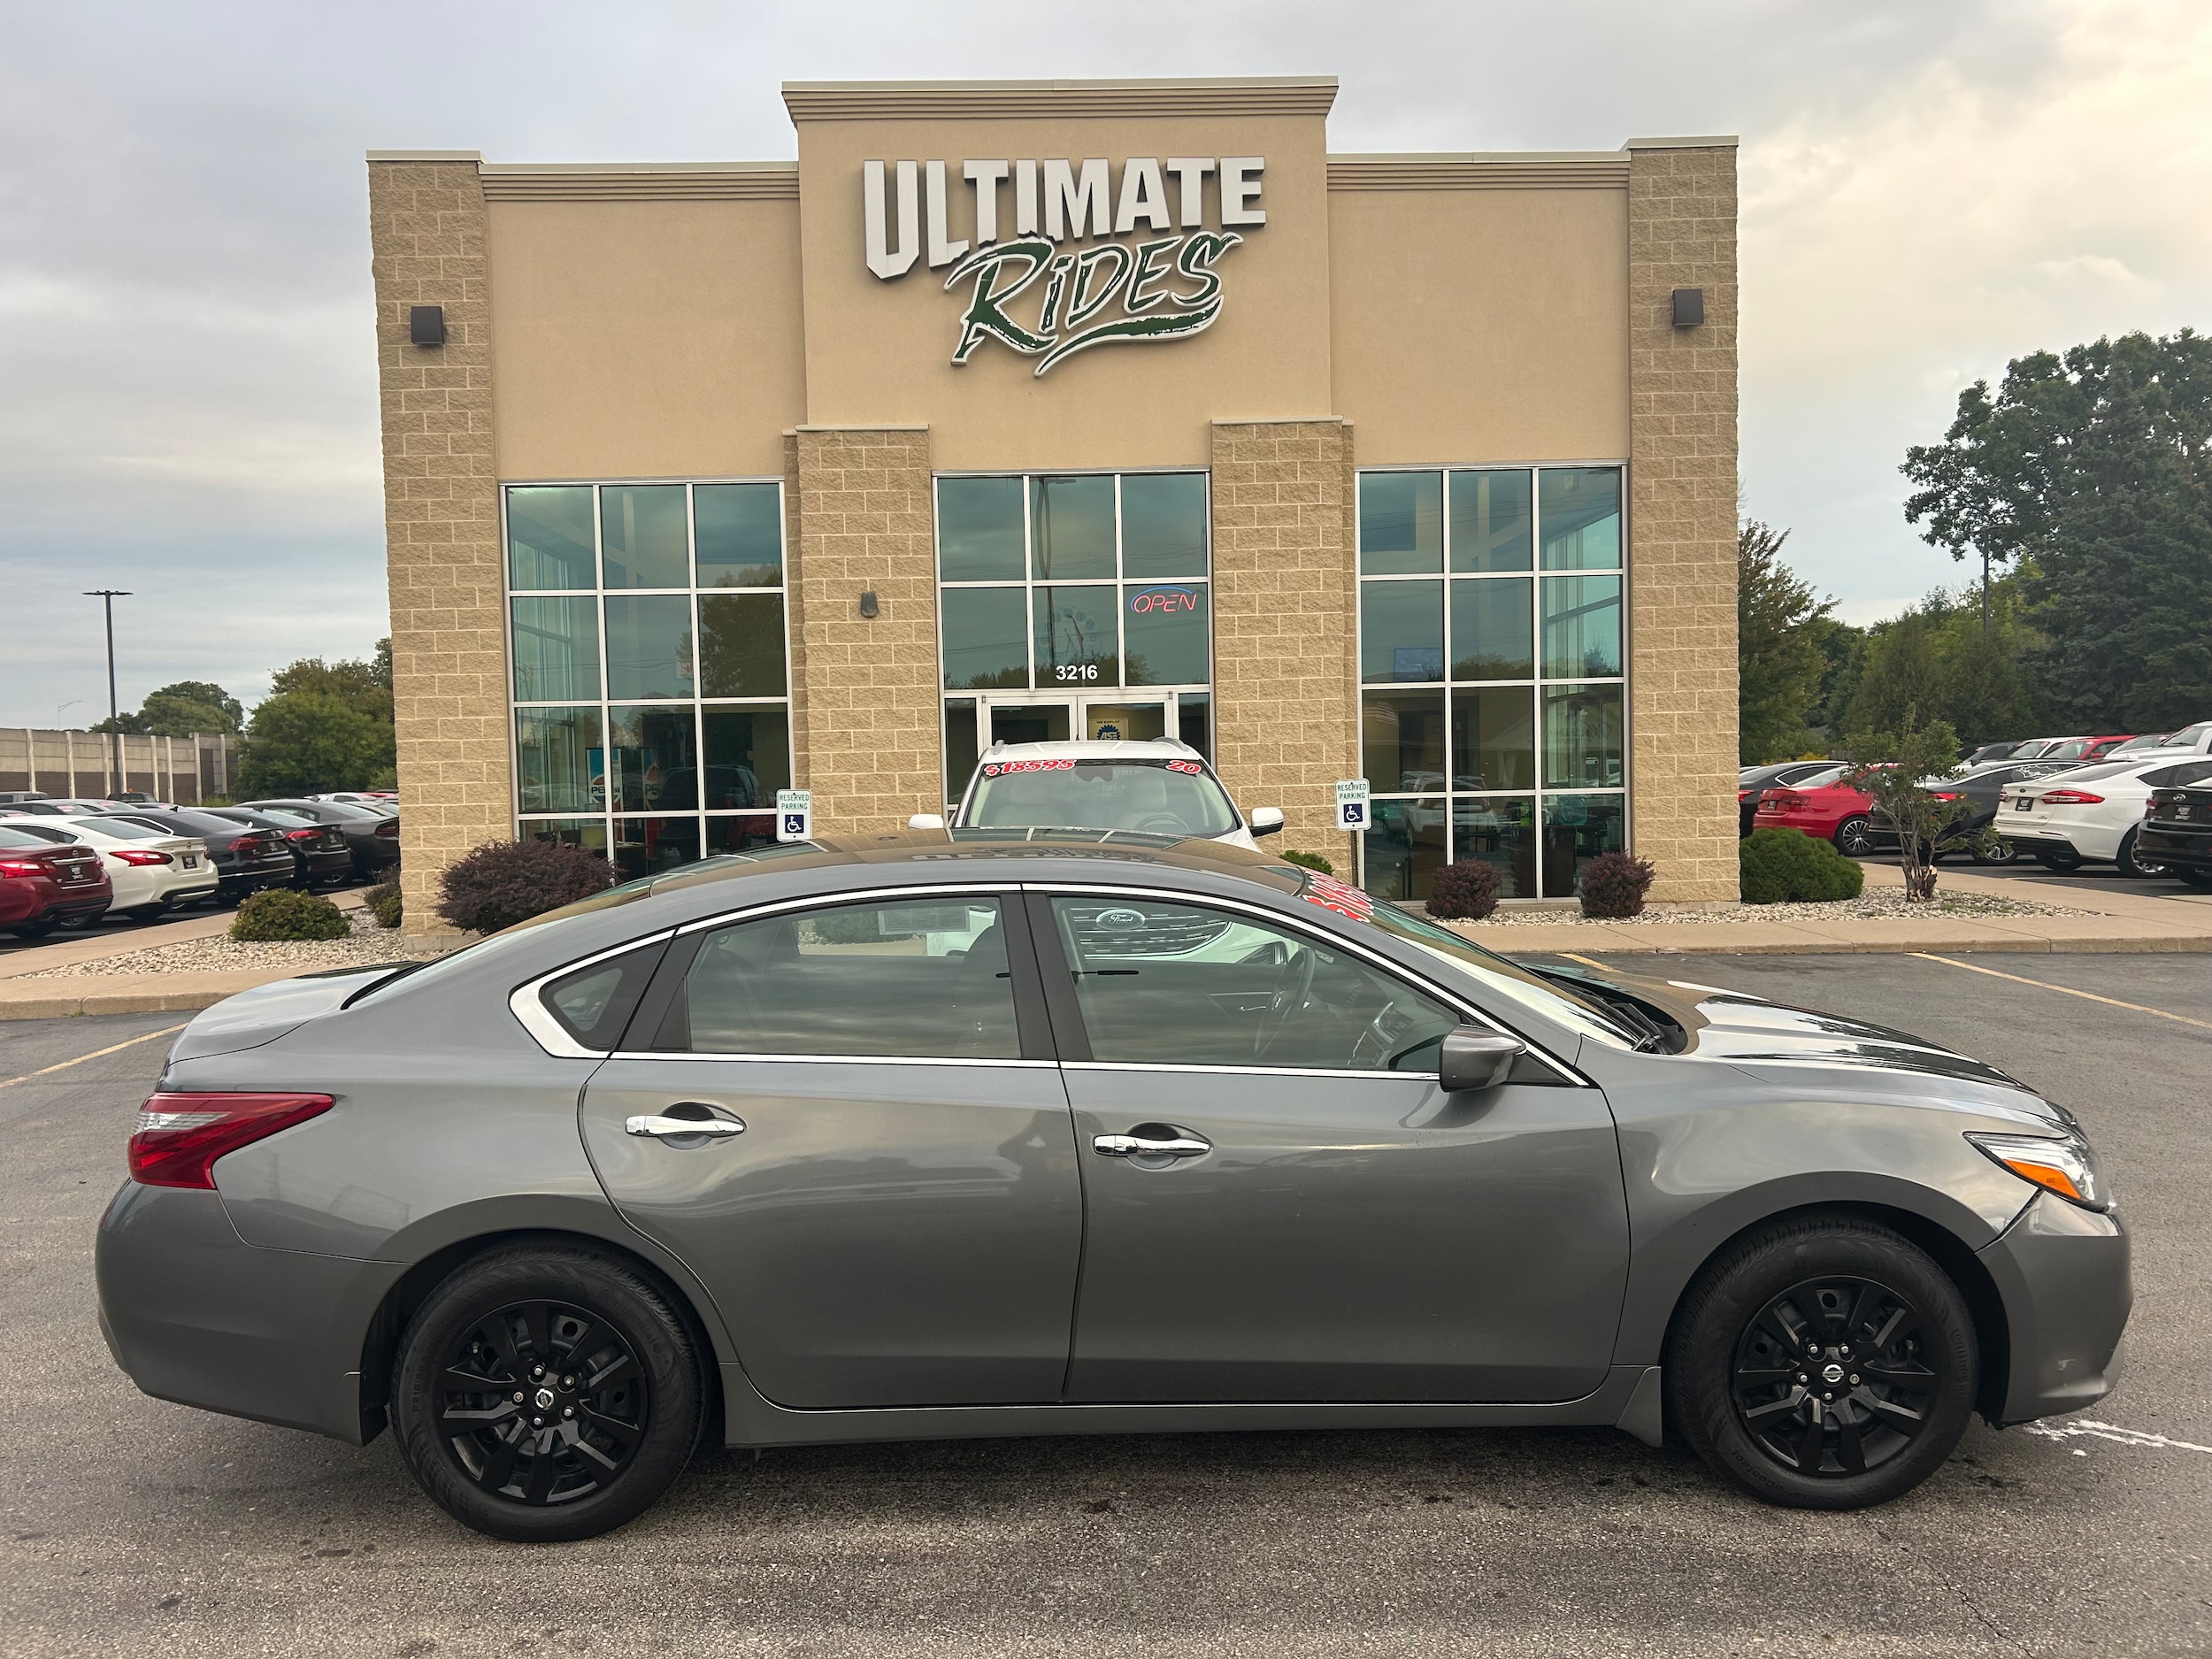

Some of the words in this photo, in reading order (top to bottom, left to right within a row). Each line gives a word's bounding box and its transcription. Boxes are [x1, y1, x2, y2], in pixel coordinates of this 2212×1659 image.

[863, 156, 1266, 281] ULTIMATE
[1133, 593, 1197, 613] OPEN
[1056, 664, 1098, 680] 3216
[1165, 760, 1202, 774] 20
[1337, 783, 1367, 792] RESERVED
[1109, 913, 1133, 925] Ford
